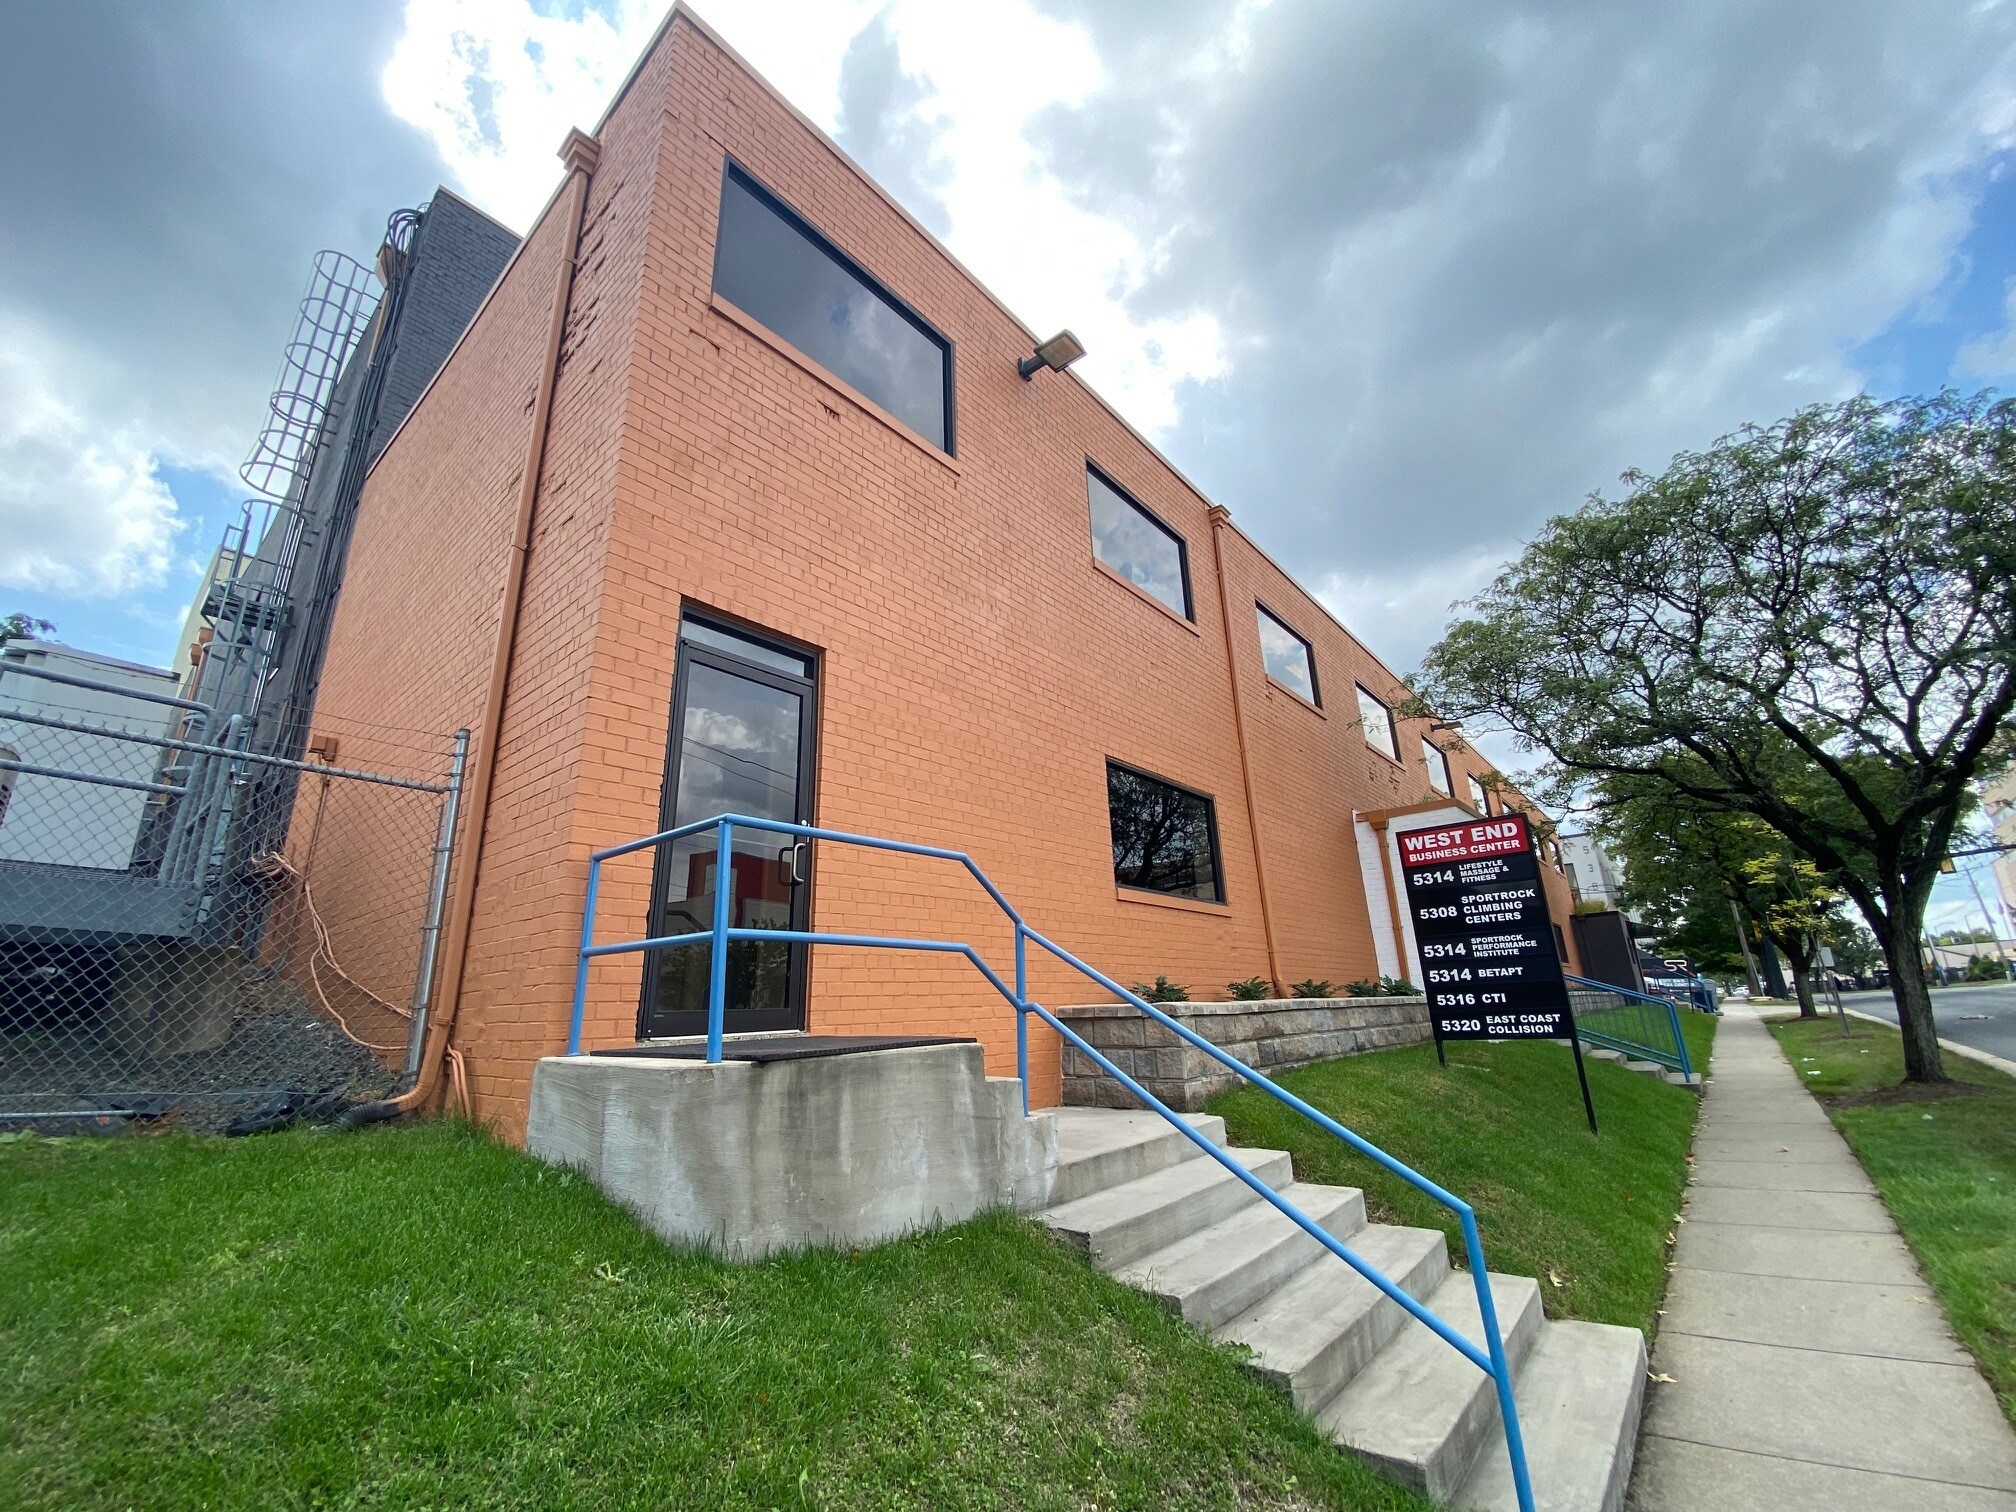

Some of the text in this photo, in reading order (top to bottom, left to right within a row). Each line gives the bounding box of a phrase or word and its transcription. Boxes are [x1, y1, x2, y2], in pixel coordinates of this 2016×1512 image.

[1404, 822, 1518, 851] WEST END
[1409, 839, 1521, 863] BUSINESS CENTER
[1458, 859, 1504, 871] LIFESTYLE
[1460, 866, 1501, 877] MASSAGE
[1413, 869, 1454, 886] 5314
[1461, 873, 1497, 884] FITNESS
[1461, 888, 1536, 904] SPORTROCK
[1420, 905, 1458, 920] 5308
[1463, 900, 1523, 914] CLIMBING
[1465, 911, 1522, 924] CENTERS
[1470, 934, 1524, 945] SPORTROCK
[1471, 939, 1538, 951] PERFORMANCE
[1423, 942, 1467, 958] 5314
[1473, 948, 1520, 958] INSTITUTE
[1478, 966, 1524, 978] BETAPT
[1663, 959, 1688, 972] SR
[1429, 968, 1472, 983] 5314
[1436, 993, 1476, 1006] 5316
[1481, 993, 1507, 1004] CTI
[1486, 1013, 1561, 1024] EAST COAST
[1441, 1019, 1481, 1032] 5320
[1488, 1024, 1554, 1034] COLLISION
